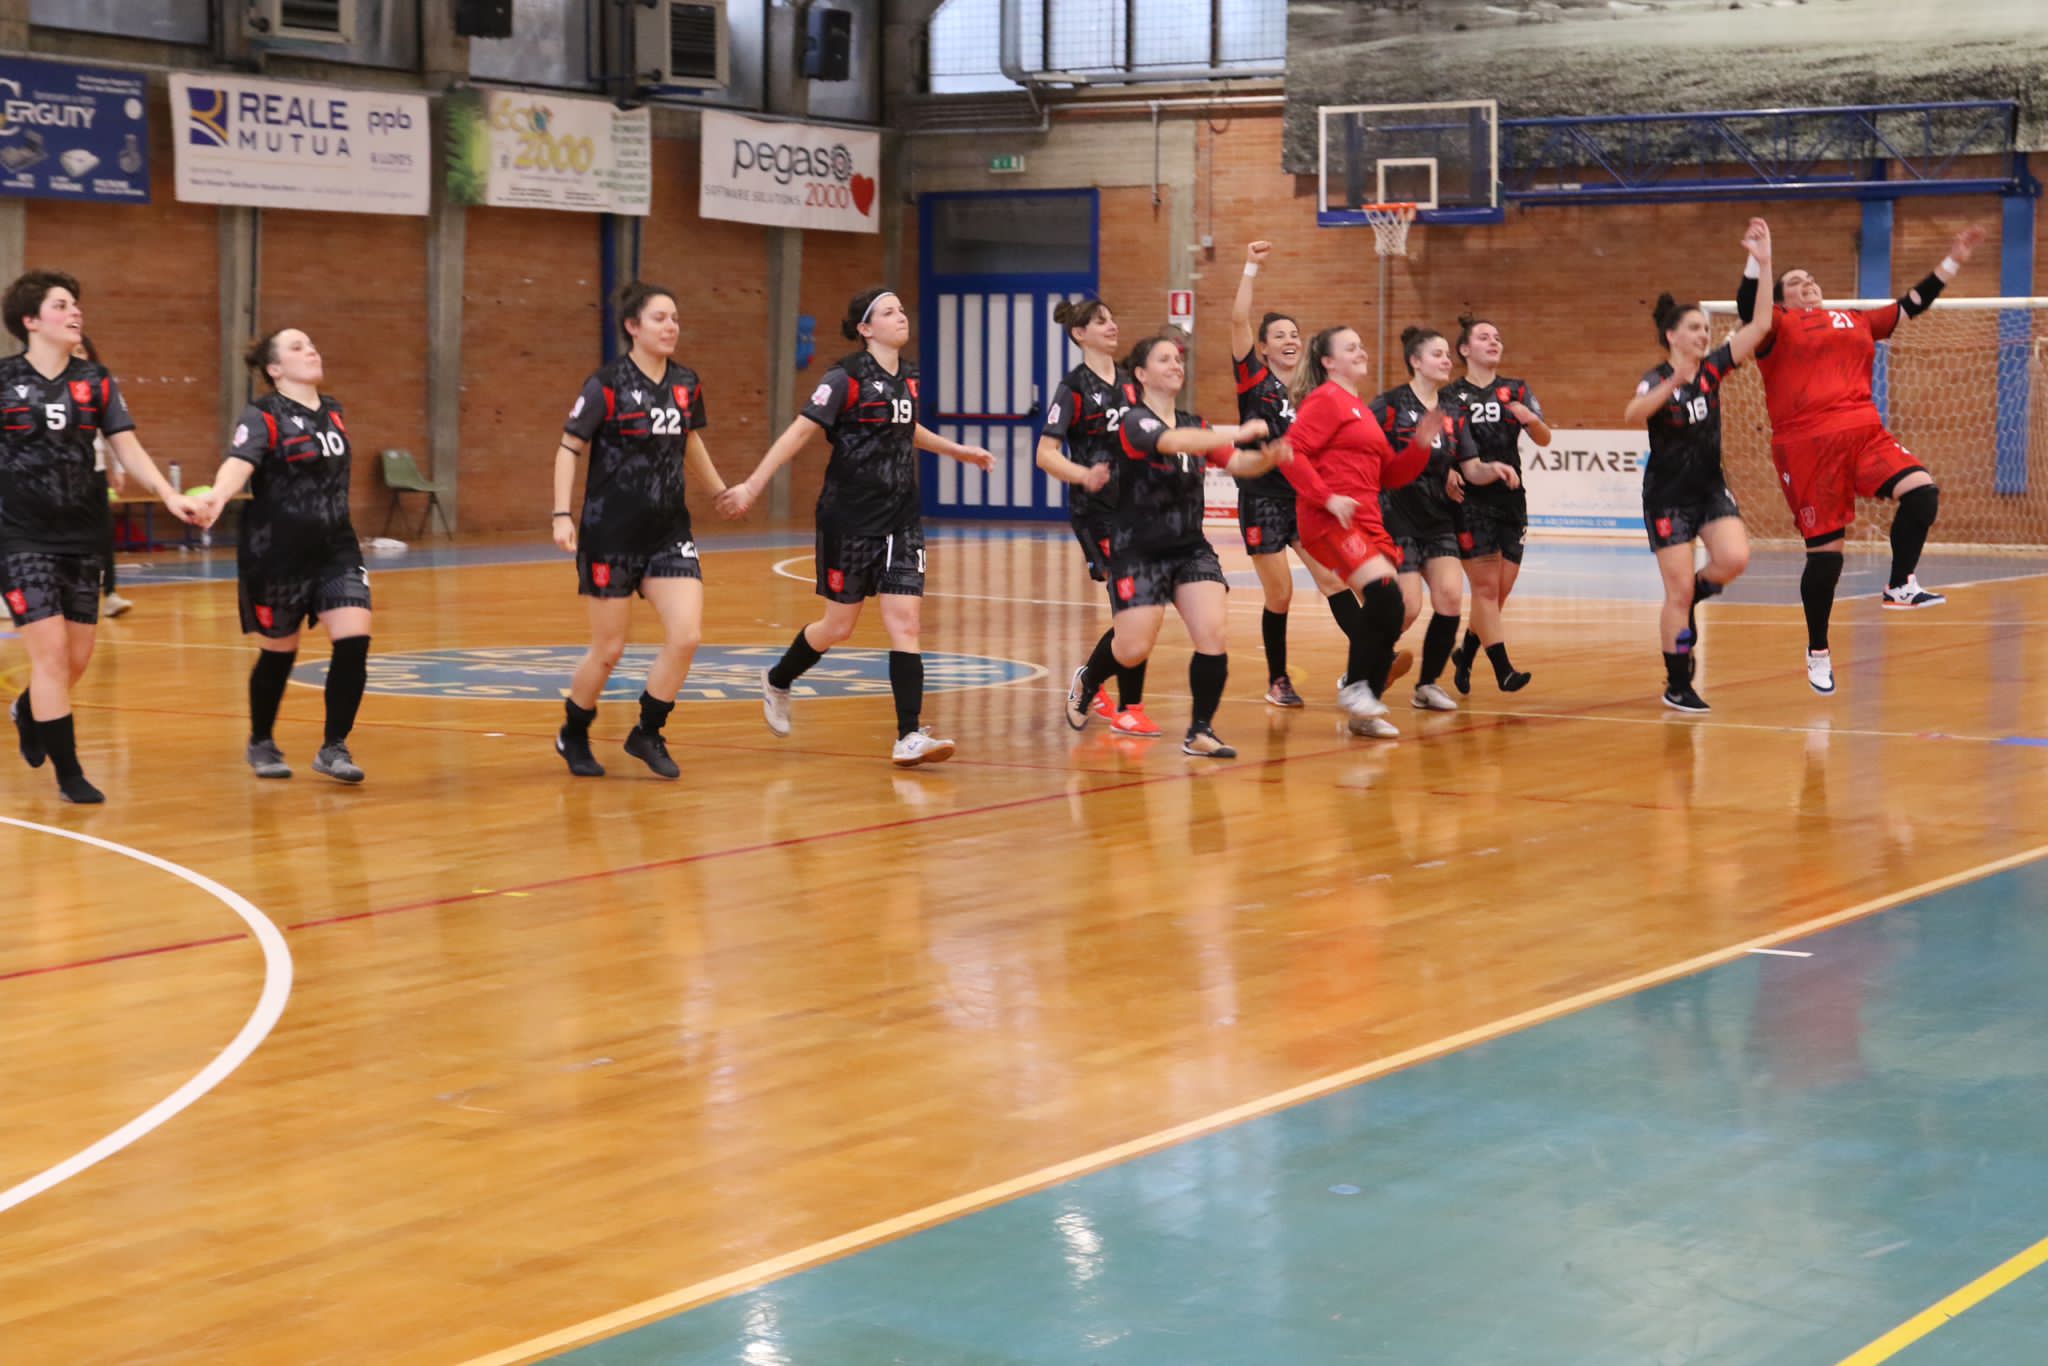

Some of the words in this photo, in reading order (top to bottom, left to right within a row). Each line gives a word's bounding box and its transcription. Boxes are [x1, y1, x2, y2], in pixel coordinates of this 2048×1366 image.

[238, 91, 350, 131] REALE
[367, 105, 412, 136] ppb
[238, 131, 352, 158] MUTUA
[514, 131, 596, 175] 2000
[732, 138, 852, 183] pegaso
[805, 182, 849, 209] 2000
[1828, 311, 1854, 329] 21
[45, 403, 67, 430] 5
[650, 407, 682, 435] 22
[891, 398, 912, 424] 19
[1470, 402, 1501, 424] 29
[315, 431, 345, 457] 10
[1529, 450, 1638, 472] ABITARE
